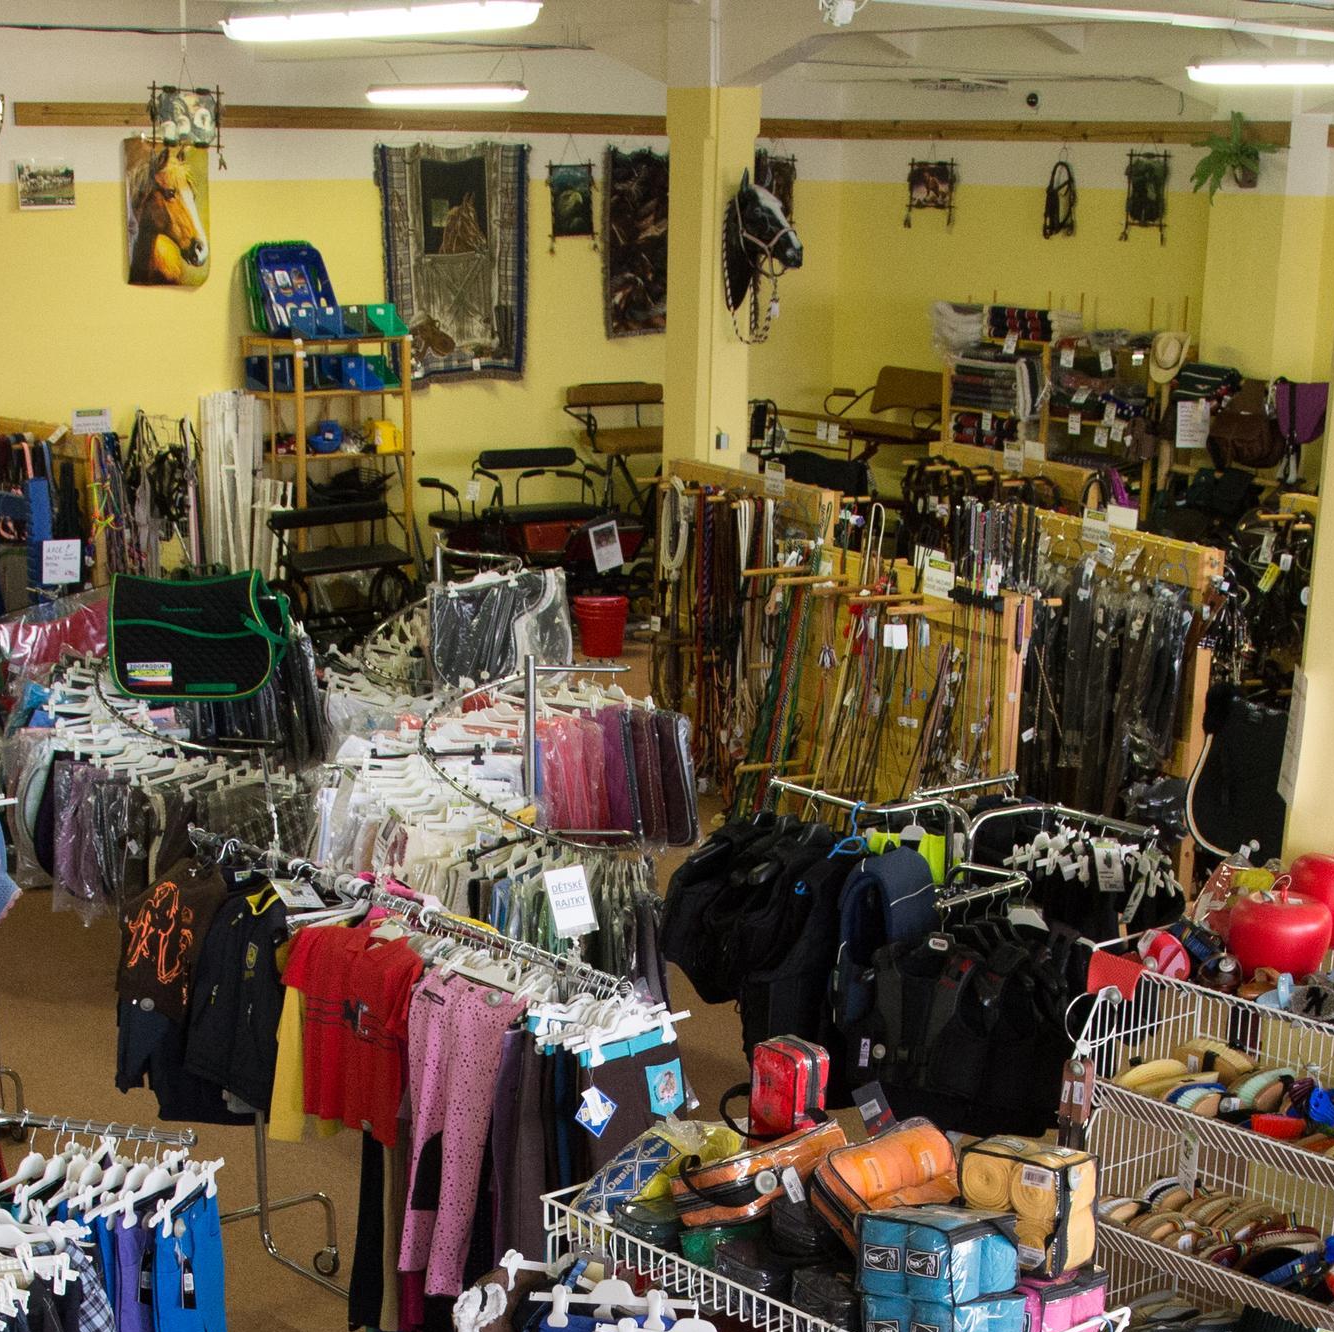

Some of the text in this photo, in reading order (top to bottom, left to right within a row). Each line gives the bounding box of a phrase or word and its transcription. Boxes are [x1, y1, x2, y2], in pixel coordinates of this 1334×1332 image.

[551, 878, 584, 893] DĚTSKÉ
[555, 896, 586, 908] RAJTKY
[642, 1139, 666, 1160] Dasl
